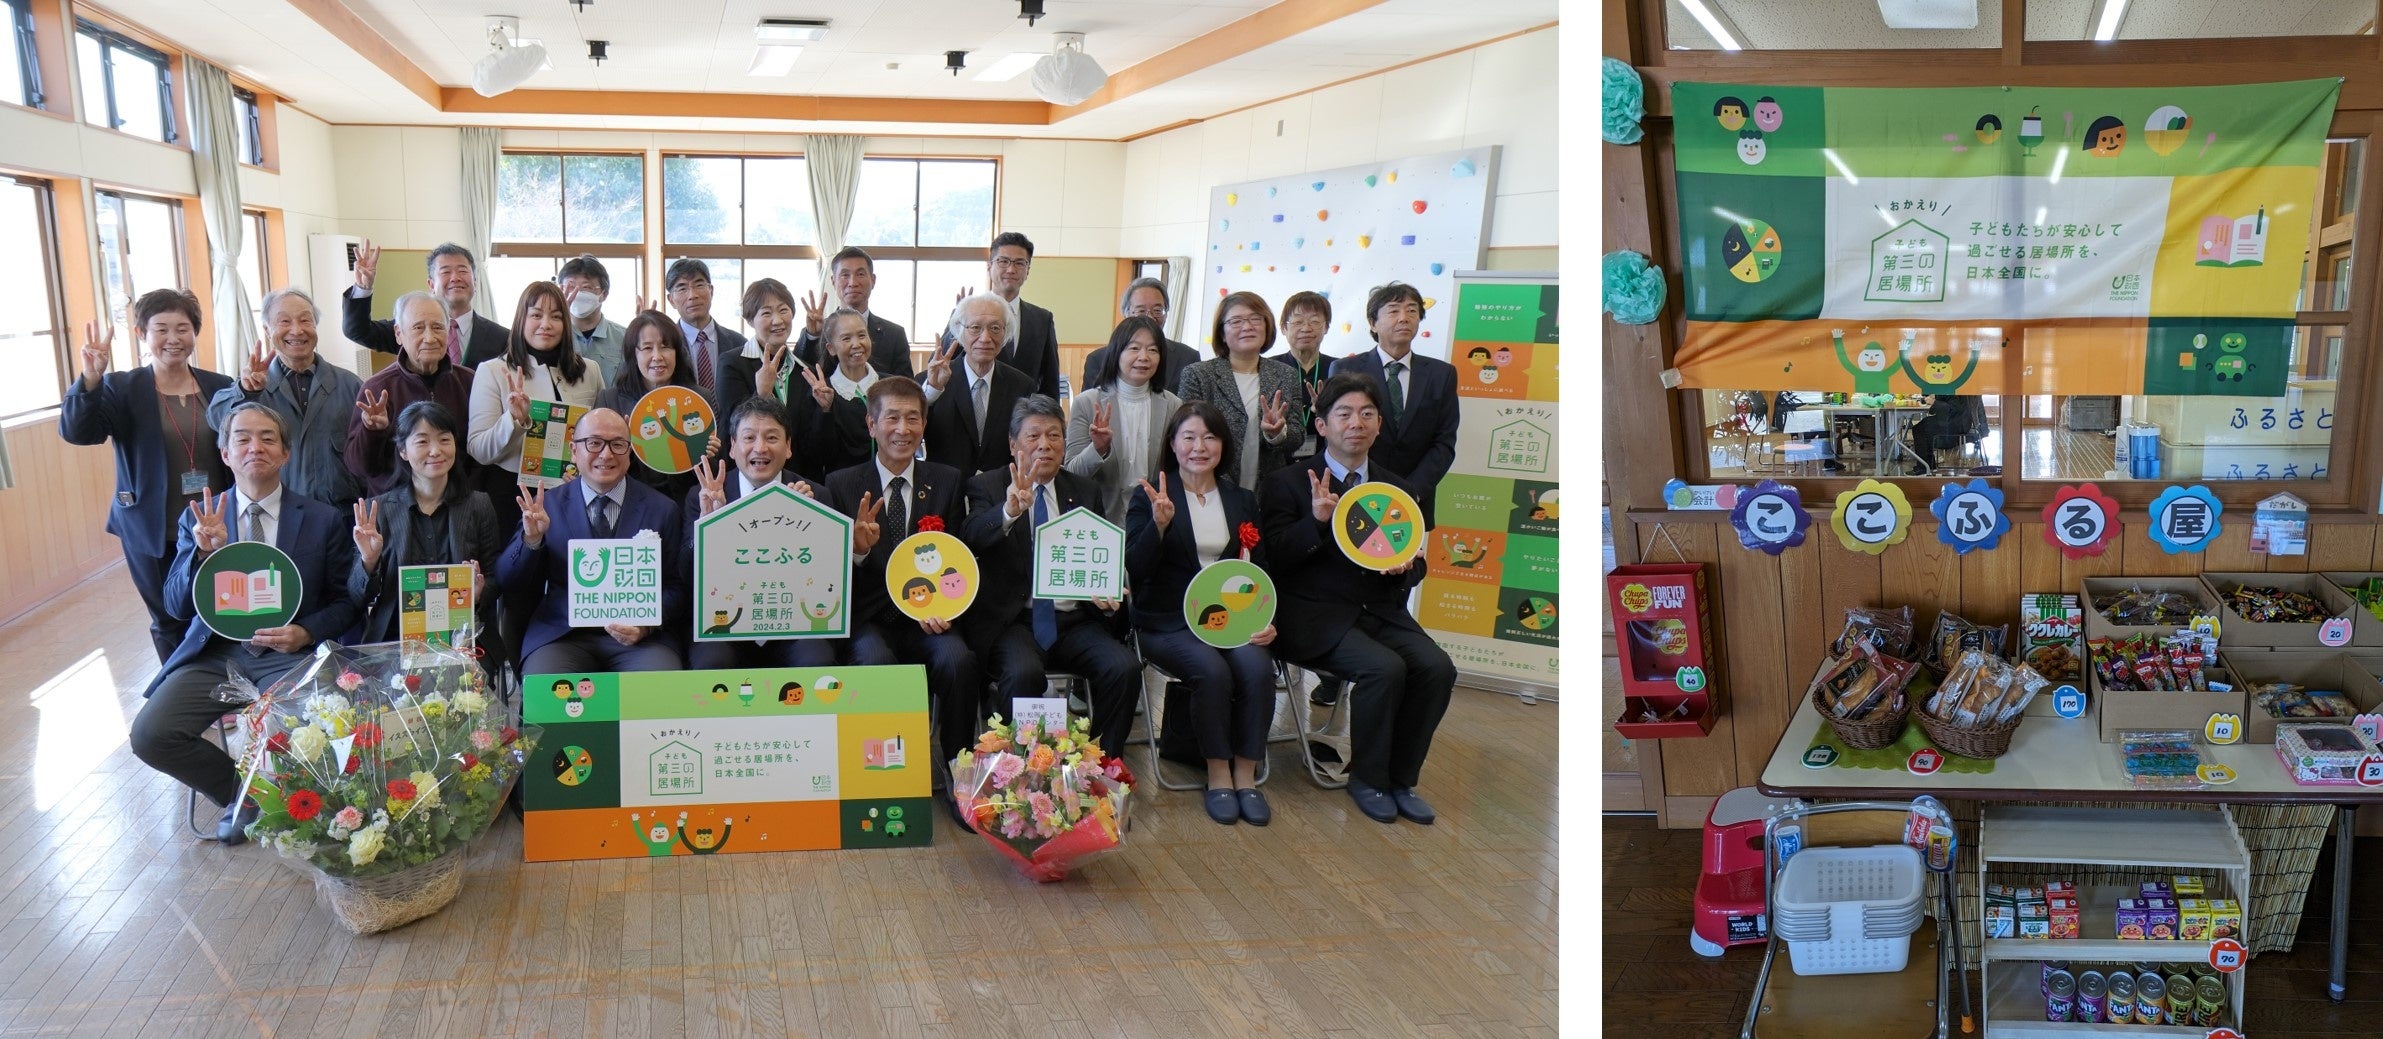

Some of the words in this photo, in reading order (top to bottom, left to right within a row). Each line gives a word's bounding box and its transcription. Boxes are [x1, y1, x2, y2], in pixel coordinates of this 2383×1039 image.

[1890, 199, 1937, 212] おかえり
[1969, 221, 2122, 237] 子どもたちが安心して
[1894, 238, 1928, 249] 子ども
[1967, 243, 2099, 259] 過ごせる居場所を、
[1883, 253, 1935, 271] 第三の
[1966, 266, 2052, 280] 日本全国に。
[1876, 274, 1933, 293] 居場所
[1505, 407, 1544, 416] おかえり
[2230, 407, 2333, 430] ふるさと
[1509, 430, 1534, 438] 子ども
[1499, 439, 1540, 452] 第三の
[1496, 452, 1538, 466] 居場所
[1693, 495, 1715, 506] 会計
[1063, 529, 1099, 540] 子ども
[614, 546, 656, 565] 日本
[735, 547, 812, 565] ここふる
[1050, 545, 1109, 564] 第三の
[1523, 554, 1559, 563] やりたいこ
[614, 568, 656, 588] 財団
[1048, 568, 1109, 588] 居場所
[760, 581, 786, 589] 子ども
[574, 592, 599, 604] THE
[603, 592, 656, 604] NIPPON
[1624, 589, 1648, 599] Chupa
[1652, 585, 1686, 600] FOREVER
[752, 593, 793, 605] 第三の
[1624, 597, 1649, 608] Chups
[1654, 599, 1683, 609] FUN
[574, 607, 657, 619] FOUNDATION
[752, 608, 793, 621] 居場所
[753, 622, 790, 631] 2024.2.3
[2029, 623, 2079, 638] ククレカレー
[2330, 630, 2341, 638] 20
[2062, 700, 2077, 708] 170
[660, 729, 692, 737] おかえり
[2216, 726, 2229, 735] 10
[714, 739, 812, 751] 子どもたちが安心して
[665, 752, 688, 760] 子ども
[714, 754, 800, 765] 過ごせる居場所を、
[1917, 758, 1929, 766] 90
[657, 762, 694, 774] 第三の
[715, 768, 771, 778] 日本全国に。
[2369, 767, 2380, 777] 30
[657, 776, 695, 789] 居場所
[2221, 955, 2235, 963] 70
